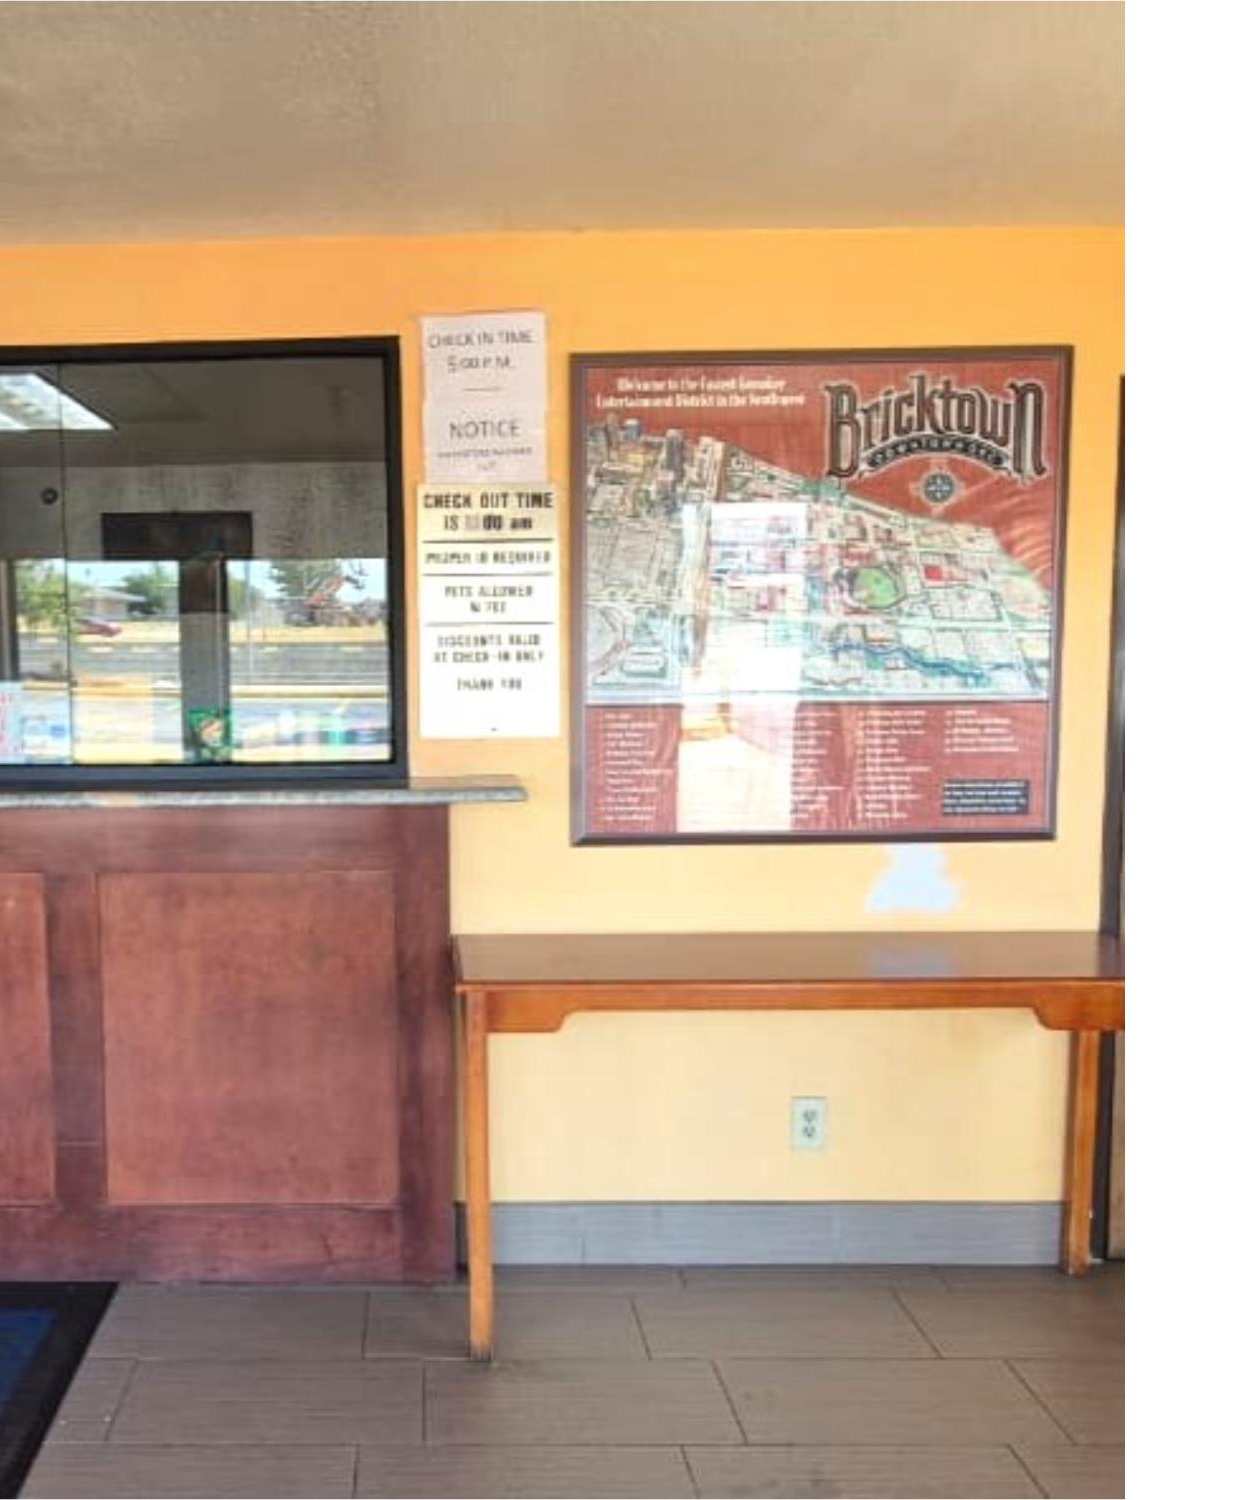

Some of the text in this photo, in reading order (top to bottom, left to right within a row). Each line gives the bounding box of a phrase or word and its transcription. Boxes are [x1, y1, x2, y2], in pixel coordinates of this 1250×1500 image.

[428, 329, 533, 348] CHECK IN TIME
[449, 420, 521, 439] NOTICE
[824, 373, 1049, 480] Bricktown
[423, 491, 554, 509] CHECK OUT TIME
[444, 514, 459, 531] IS
[510, 516, 532, 530] am
[493, 550, 551, 565] REQUIRED
[444, 585, 534, 598] PETS ALLOWED
[437, 633, 541, 647] DISCOUNTS VALID
[457, 677, 523, 691] THANK YOU
